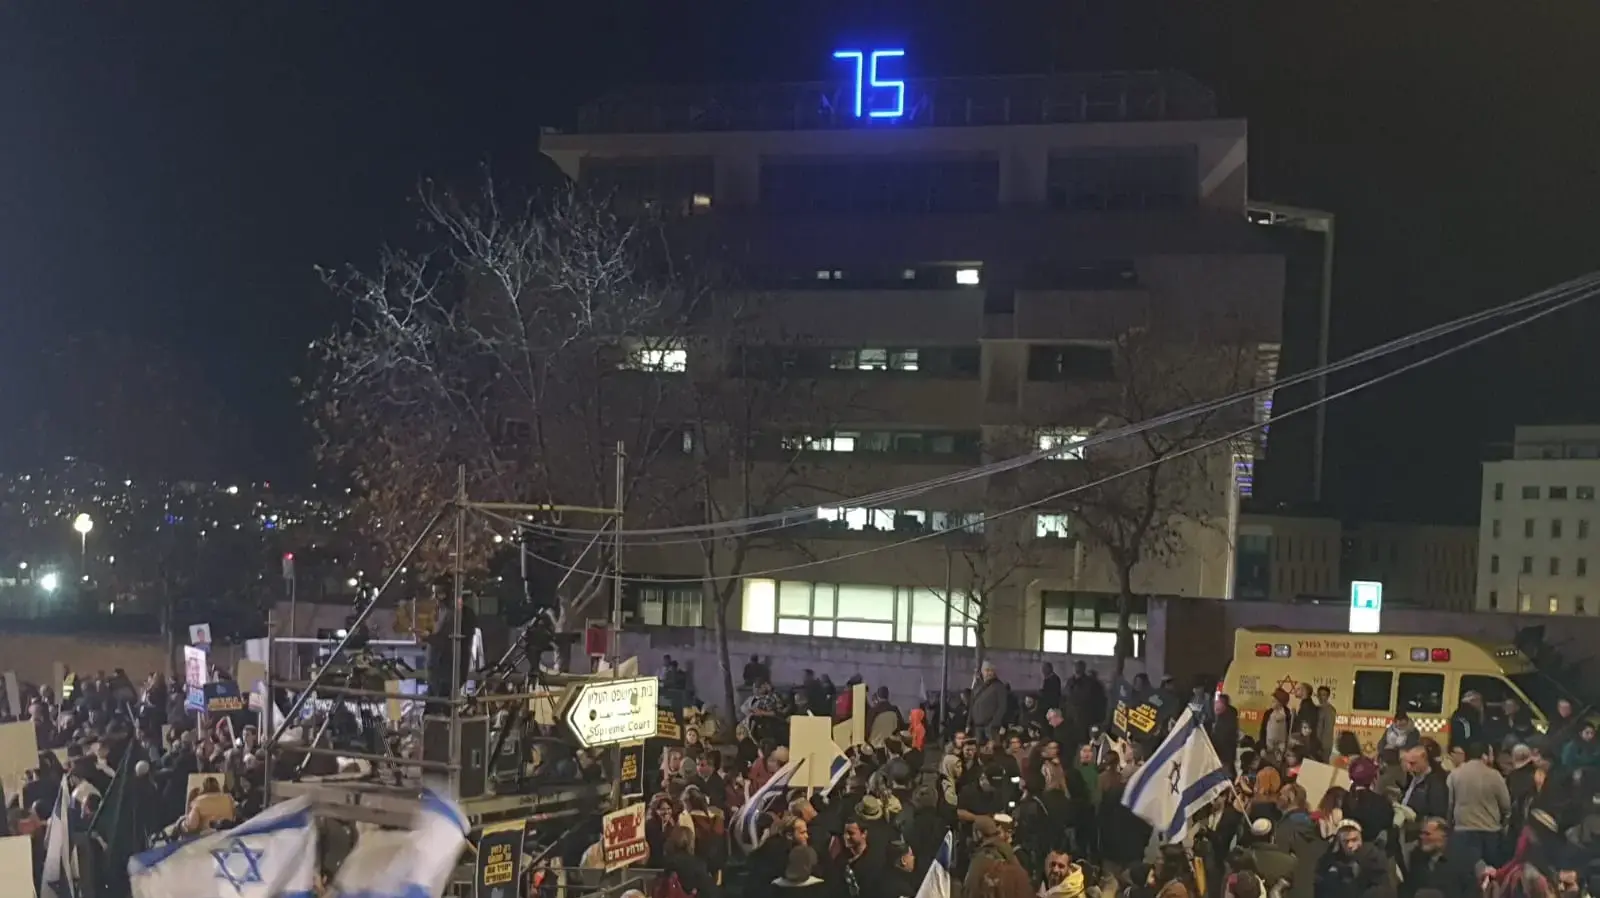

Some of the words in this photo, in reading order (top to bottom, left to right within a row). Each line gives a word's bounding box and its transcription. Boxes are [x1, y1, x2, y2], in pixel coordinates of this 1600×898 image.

[832, 49, 906, 118] 75
[641, 685, 653, 697] בית
[588, 691, 608, 708] העליון
[1335, 715, 1349, 725] AGEN
[1350, 716, 1368, 726] DAVID
[1368, 717, 1386, 727] ADOM
[589, 724, 626, 739] Supreme
[628, 720, 651, 732] Court
[626, 842, 645, 857] מרחץ
